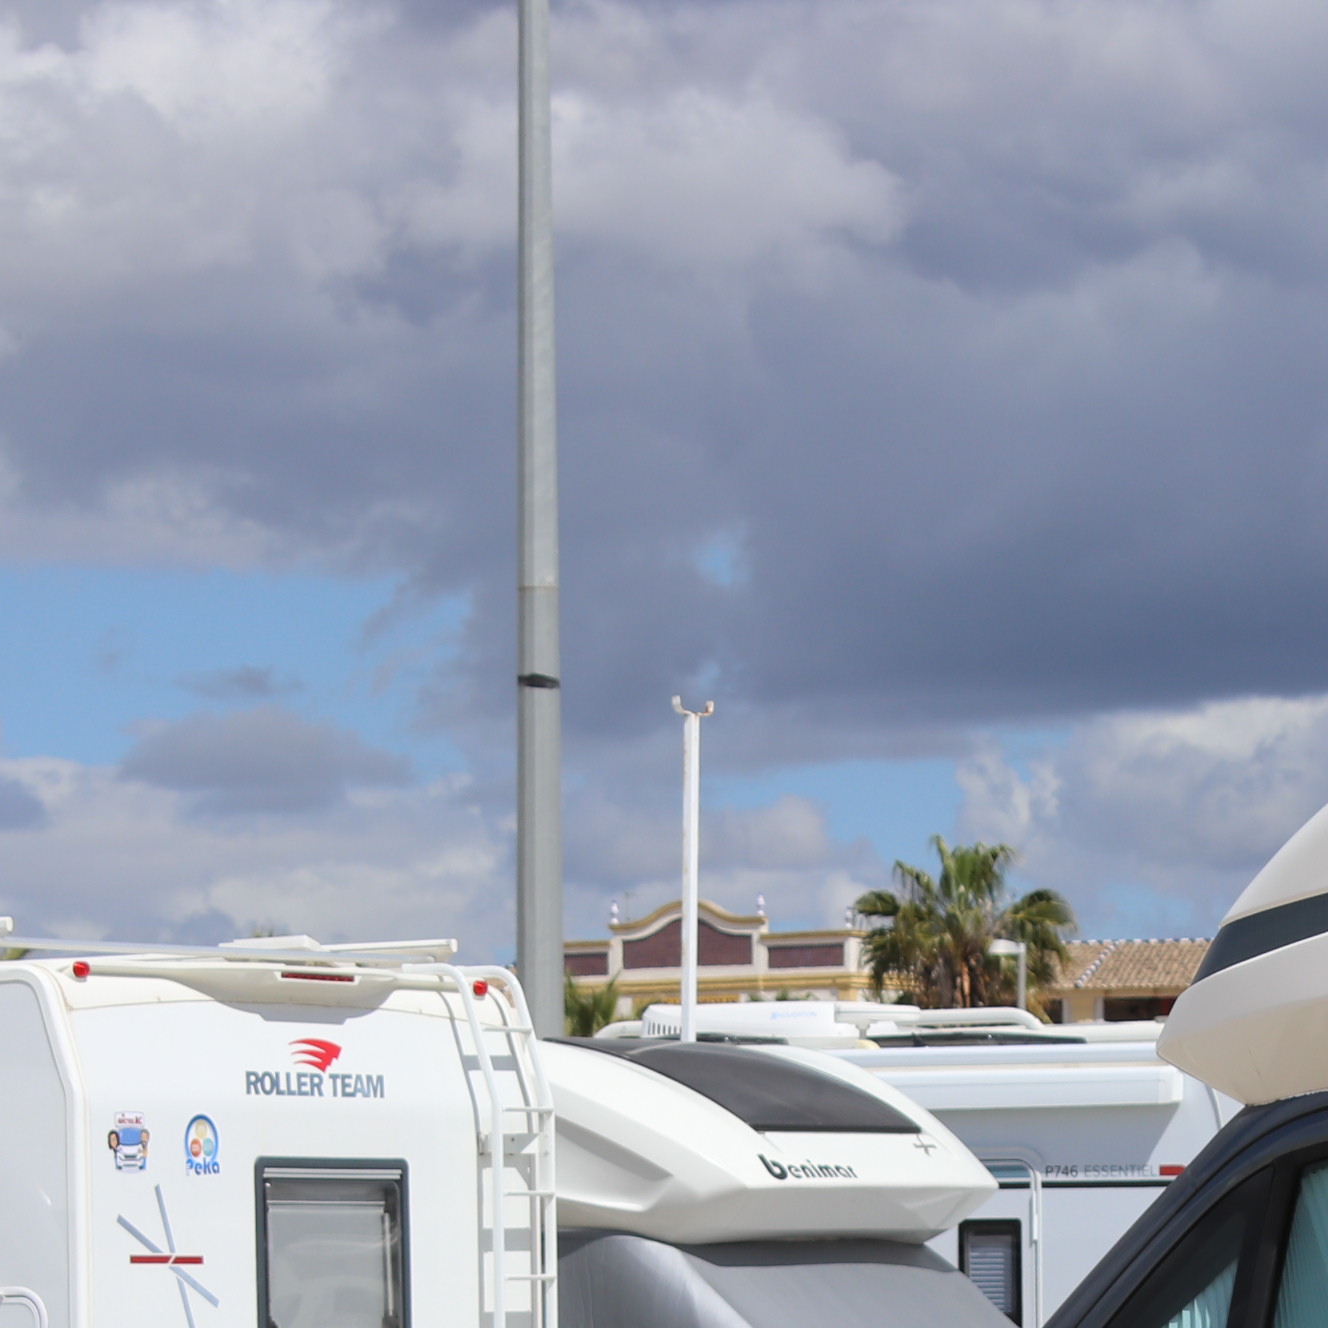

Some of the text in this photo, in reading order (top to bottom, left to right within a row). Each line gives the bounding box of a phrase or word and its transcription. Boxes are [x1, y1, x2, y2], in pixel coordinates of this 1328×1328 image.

[245, 1070, 385, 1098] ROLLER TEAM
[757, 1153, 858, 1180] benimar
[1045, 1164, 1157, 1177] P746 ESSENTIEL
